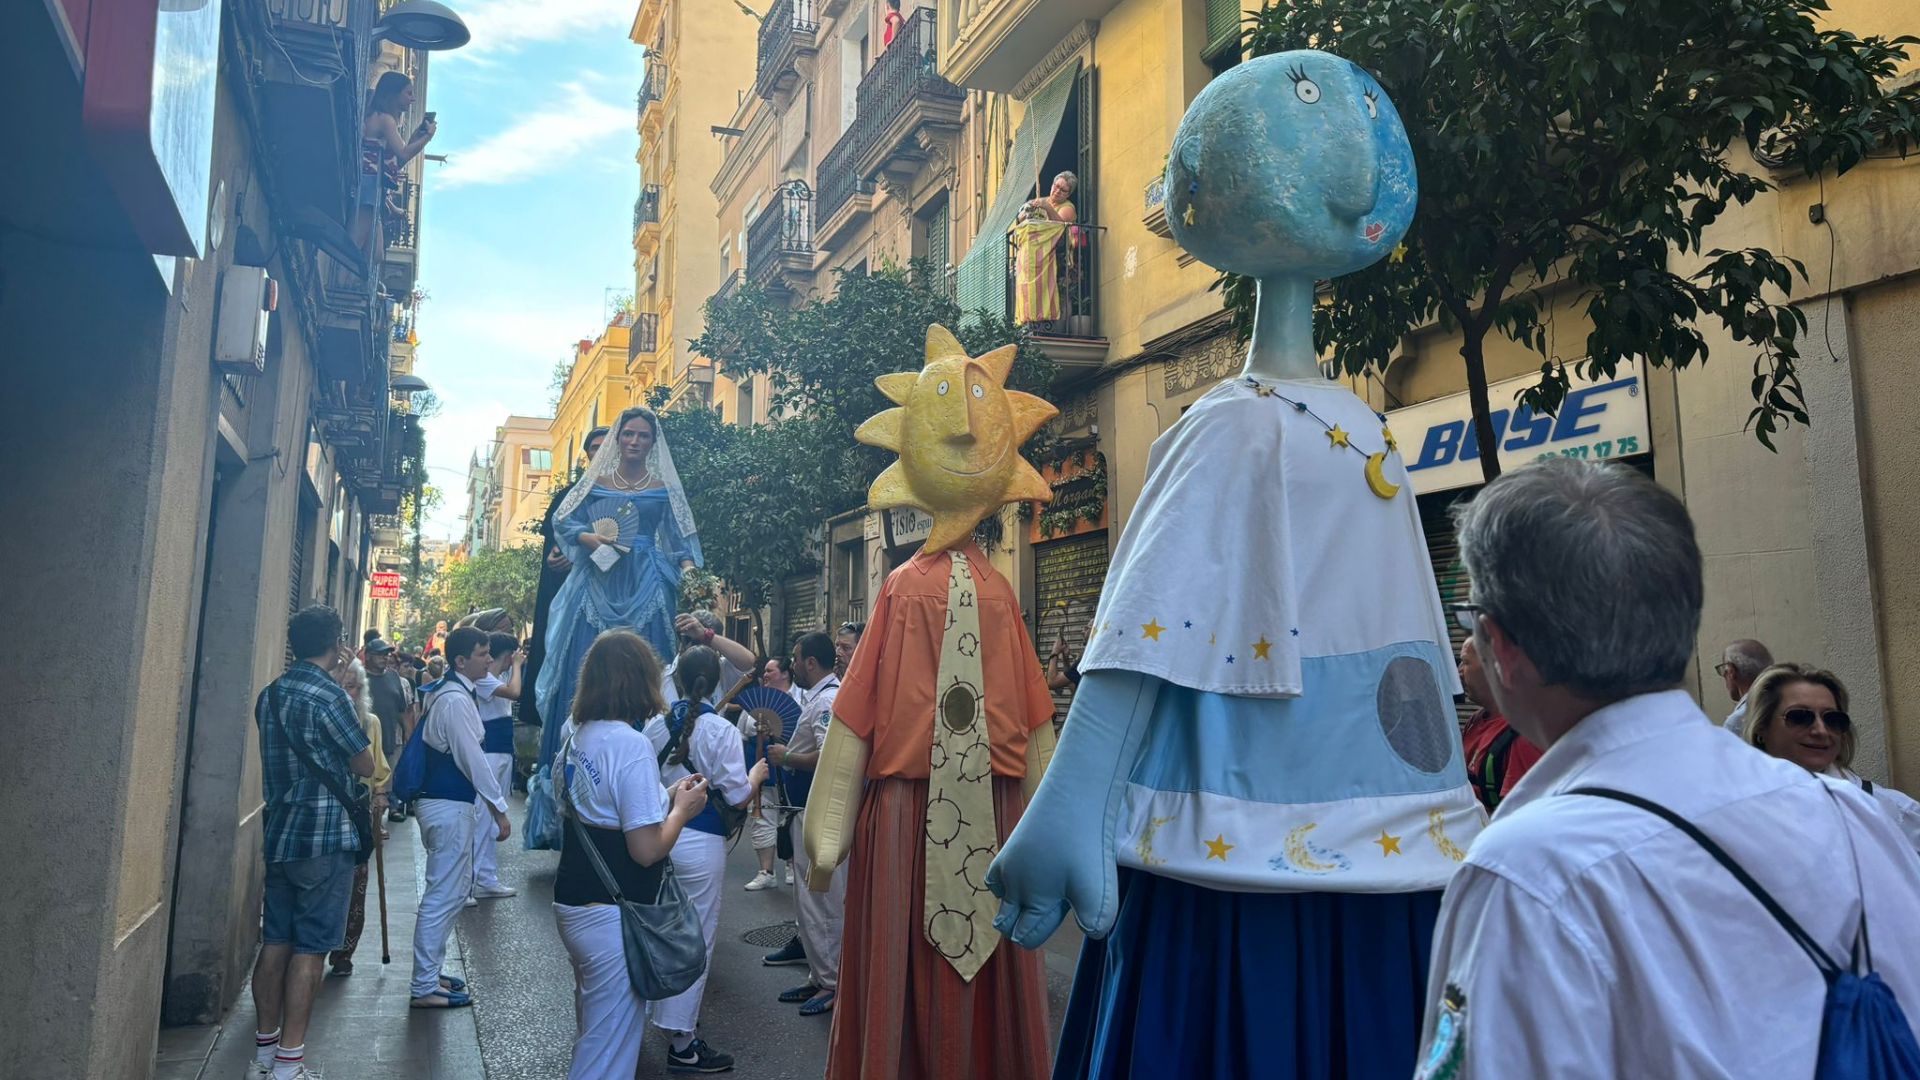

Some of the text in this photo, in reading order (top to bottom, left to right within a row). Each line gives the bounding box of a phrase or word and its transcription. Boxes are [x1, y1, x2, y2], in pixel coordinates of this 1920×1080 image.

[1406, 377, 1638, 472] BOSE
[1593, 441, 1612, 458] 17
[1617, 436, 1639, 454] 75
[373, 576, 398, 586] SUPER
